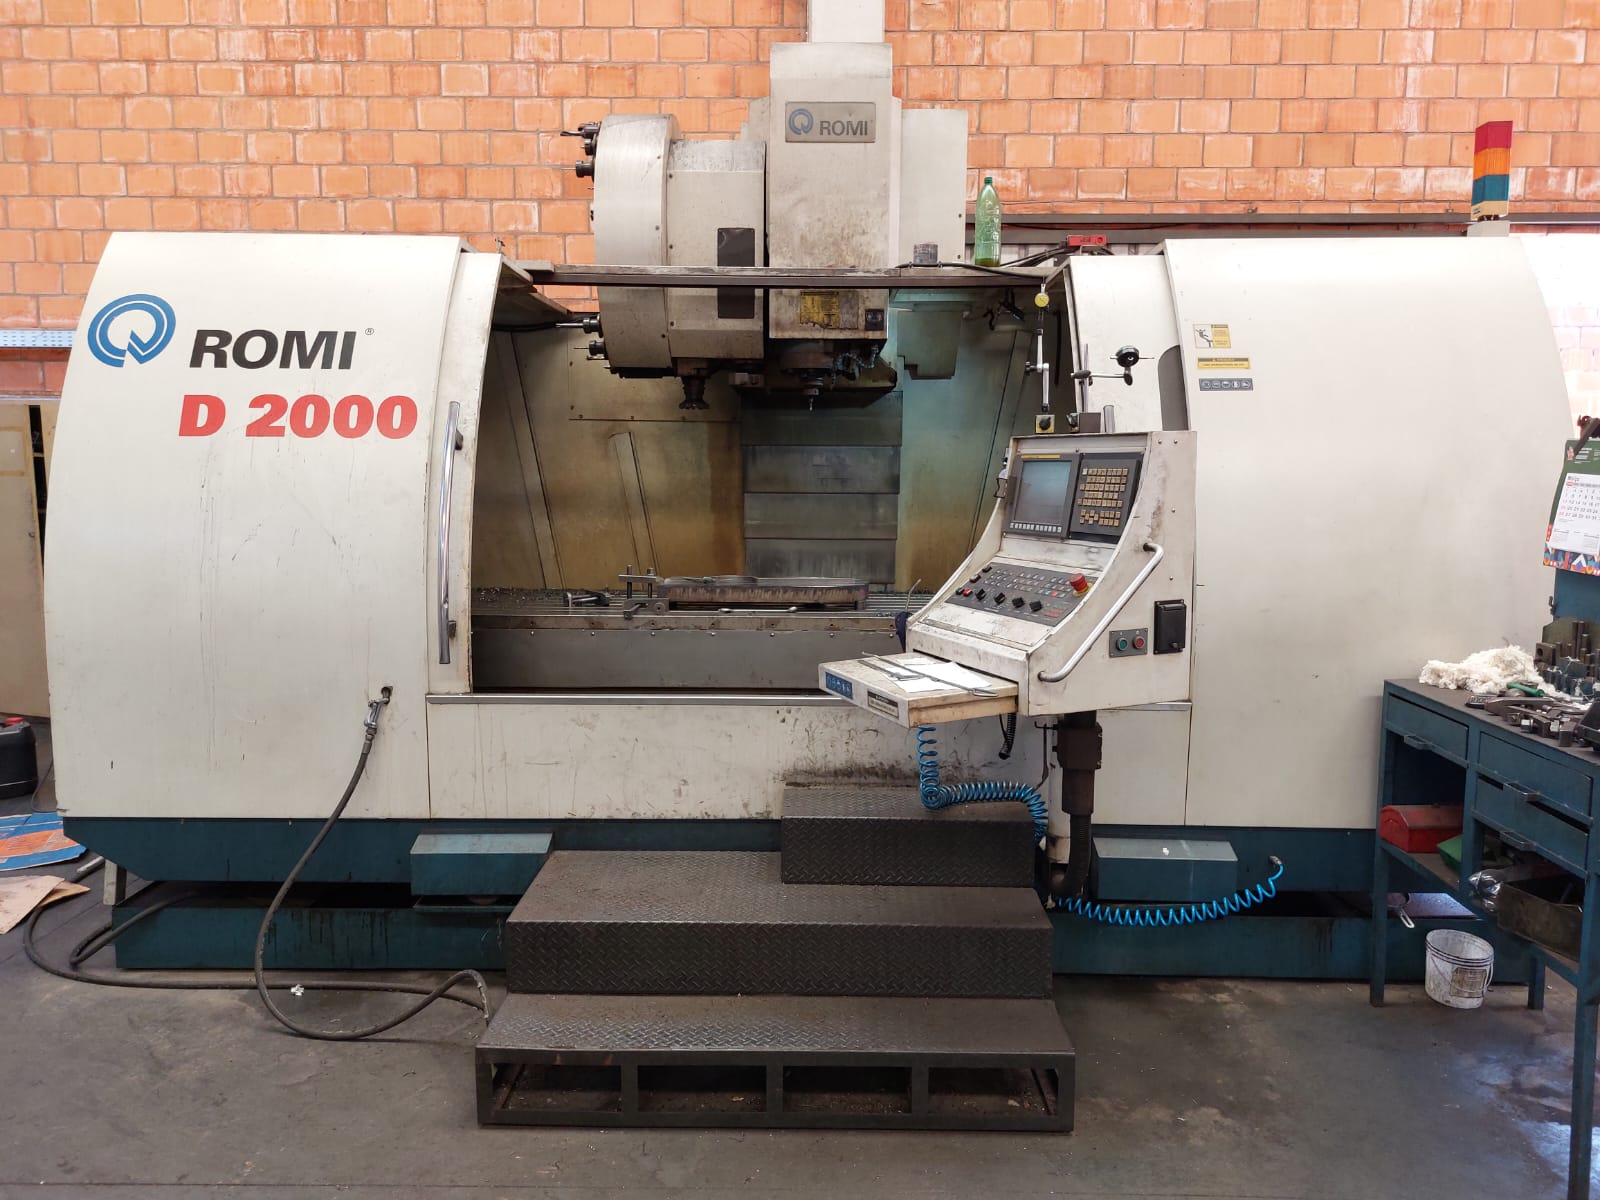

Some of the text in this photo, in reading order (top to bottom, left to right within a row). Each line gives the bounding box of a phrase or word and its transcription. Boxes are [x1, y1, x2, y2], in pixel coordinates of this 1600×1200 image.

[819, 120, 868, 136] ROMI
[189, 328, 357, 370] ROMI
[178, 393, 418, 439] D 2000
